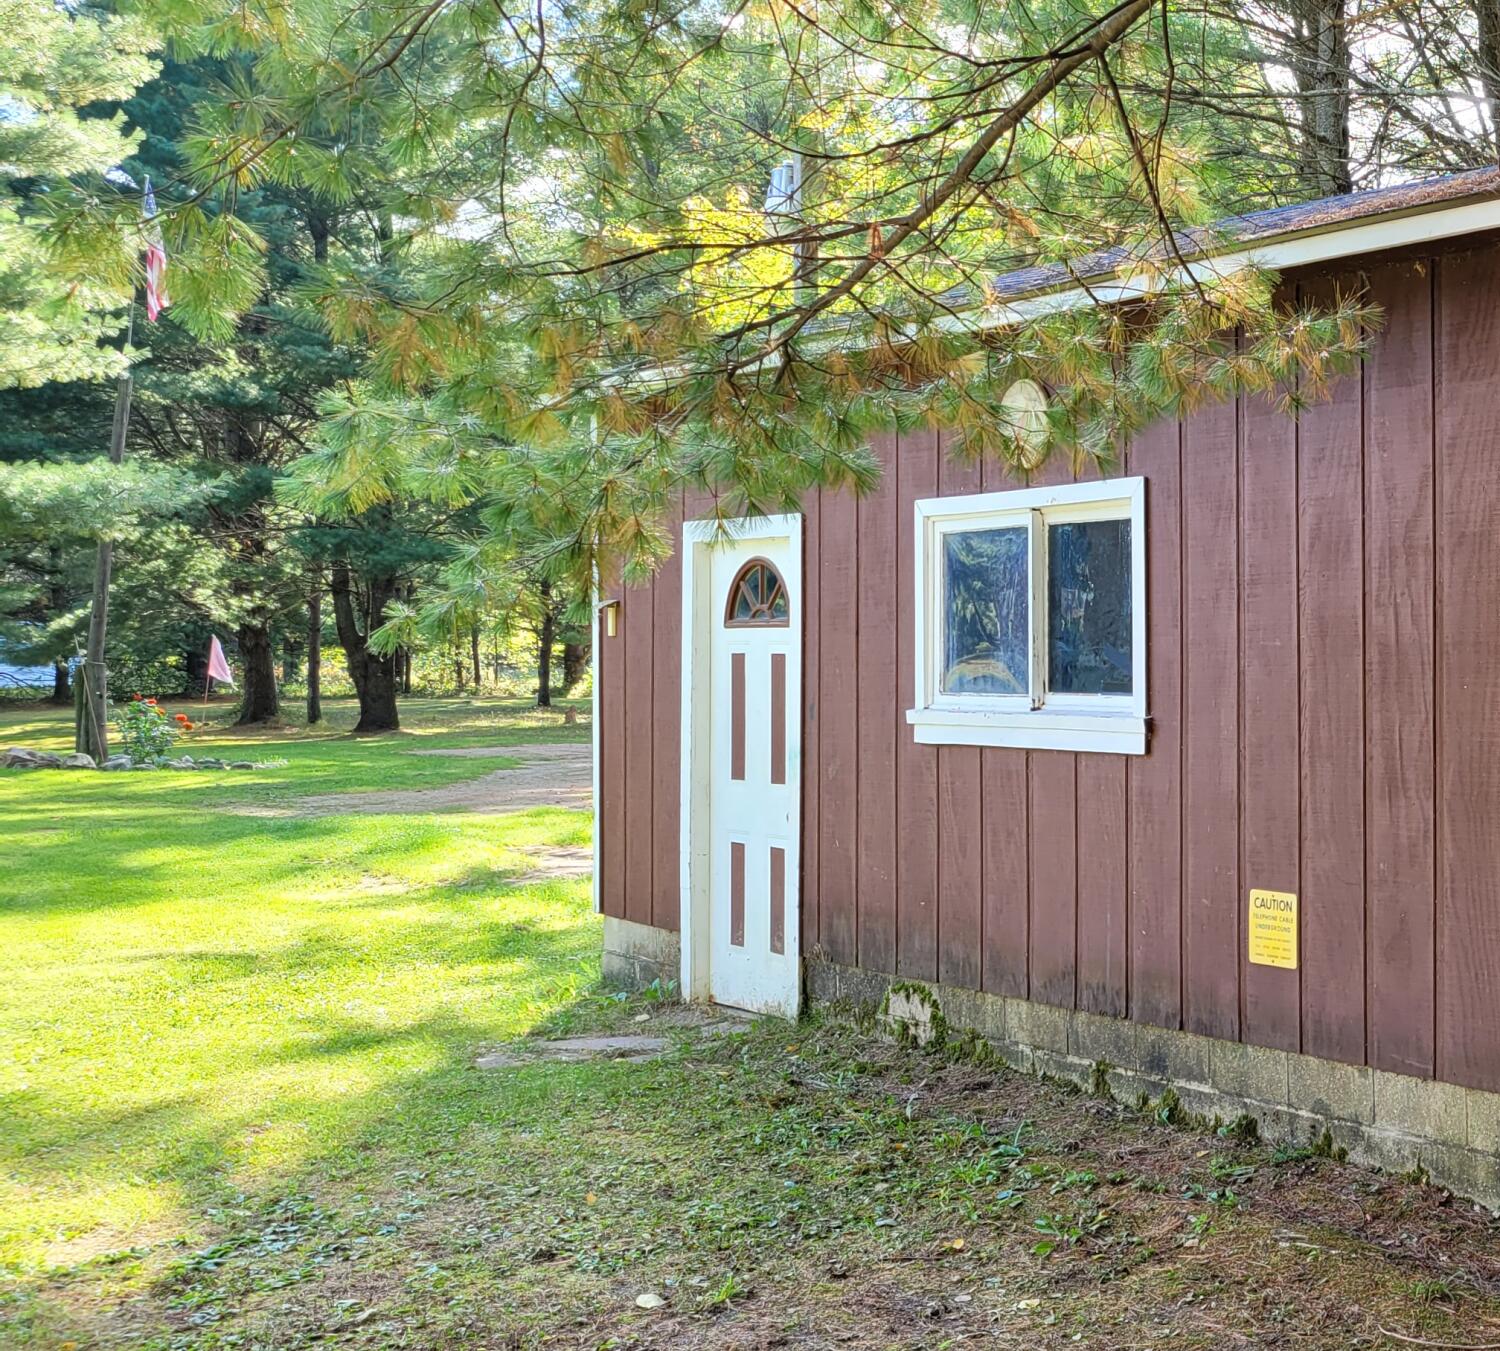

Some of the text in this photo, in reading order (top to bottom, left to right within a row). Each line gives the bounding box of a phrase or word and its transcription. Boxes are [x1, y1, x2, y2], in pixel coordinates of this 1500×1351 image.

[1254, 897, 1293, 912] CAUTION
[1253, 912, 1294, 924] TELEPHONE CABLE
